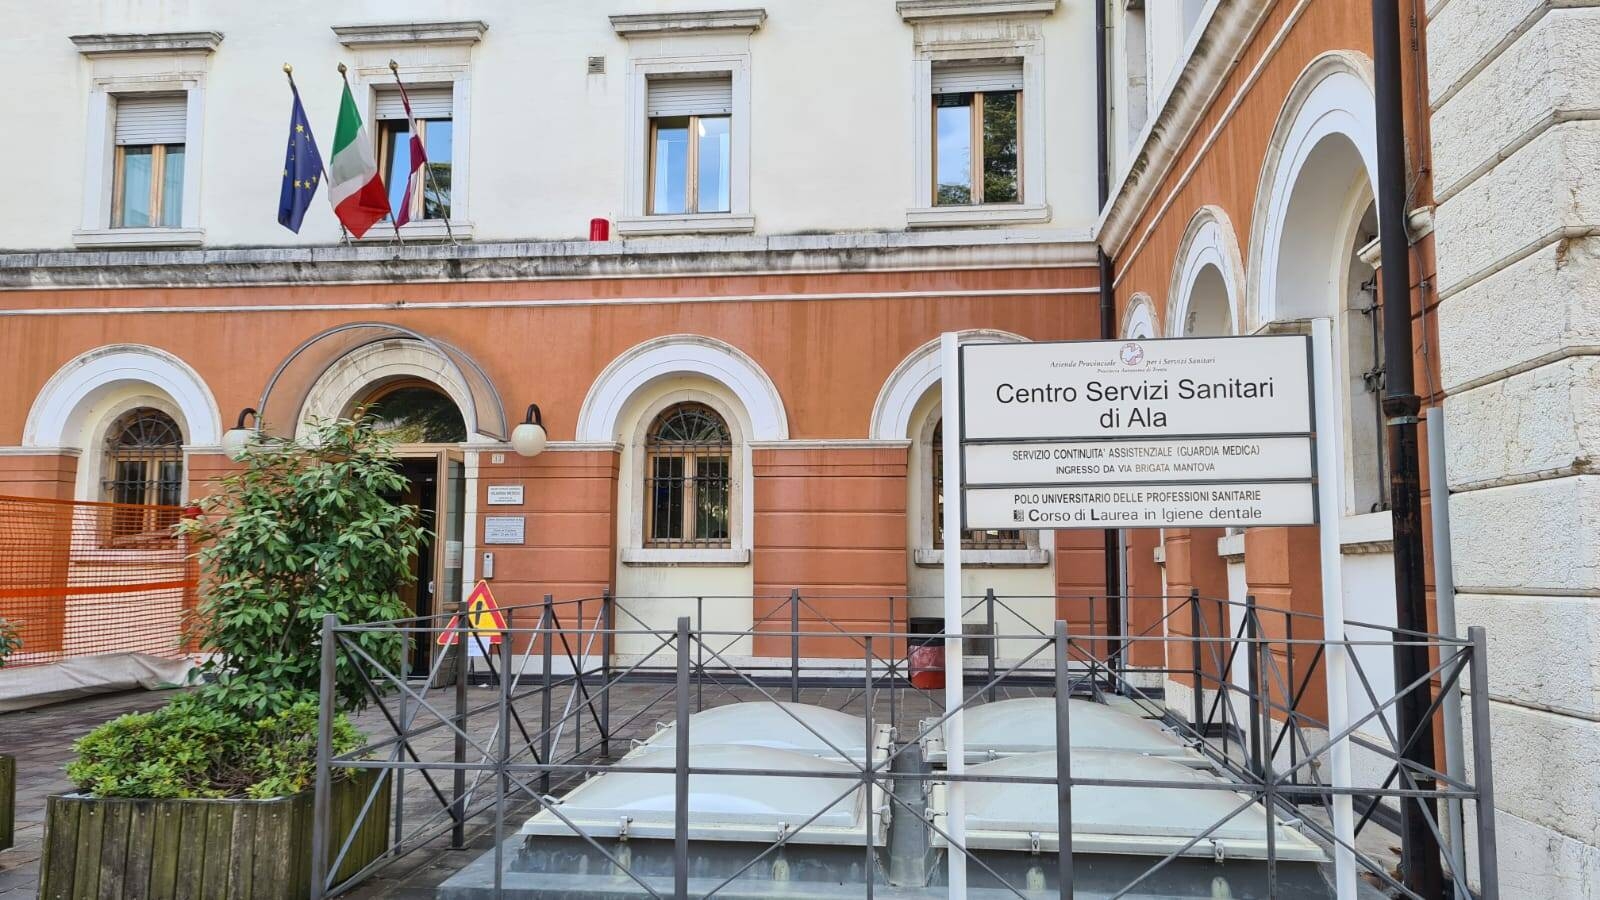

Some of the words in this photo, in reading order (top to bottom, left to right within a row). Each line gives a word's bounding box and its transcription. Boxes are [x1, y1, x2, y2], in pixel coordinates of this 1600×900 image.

[1050, 360, 1076, 368] Azienda
[1078, 360, 1116, 368] Provinciale
[996, 383, 1077, 404] Centro
[1086, 380, 1168, 401] Servizi
[1178, 377, 1274, 400] Sanitari
[1100, 408, 1120, 428] di
[1127, 407, 1168, 428] Ala
[1012, 450, 1050, 460] SERVIZIO
[1054, 448, 1106, 459] CONTINUITA'
[1108, 448, 1172, 458] ASSISTENZIALE
[1177, 446, 1219, 456] (GUARDIA
[1222, 445, 1260, 456] MEDICA)
[1056, 465, 1100, 474] INGRESSO
[1103, 464, 1114, 474] DA
[1118, 464, 1132, 472] VIA
[1136, 464, 1170, 472] BRIGATA
[1174, 462, 1215, 472] MANTOVA
[1014, 494, 1040, 504] POLO
[1042, 493, 1110, 504] UNIVERSITARIO
[1114, 492, 1143, 502] DELLE
[1146, 492, 1208, 502] PROFESSIONI
[1212, 490, 1261, 500] SANITARIE
[1028, 509, 1070, 522] Corso
[1074, 509, 1086, 520] di
[1091, 508, 1138, 520] Laurea
[1144, 508, 1156, 520] in
[1162, 508, 1203, 522] Igiene
[1209, 506, 1262, 518] dentale
